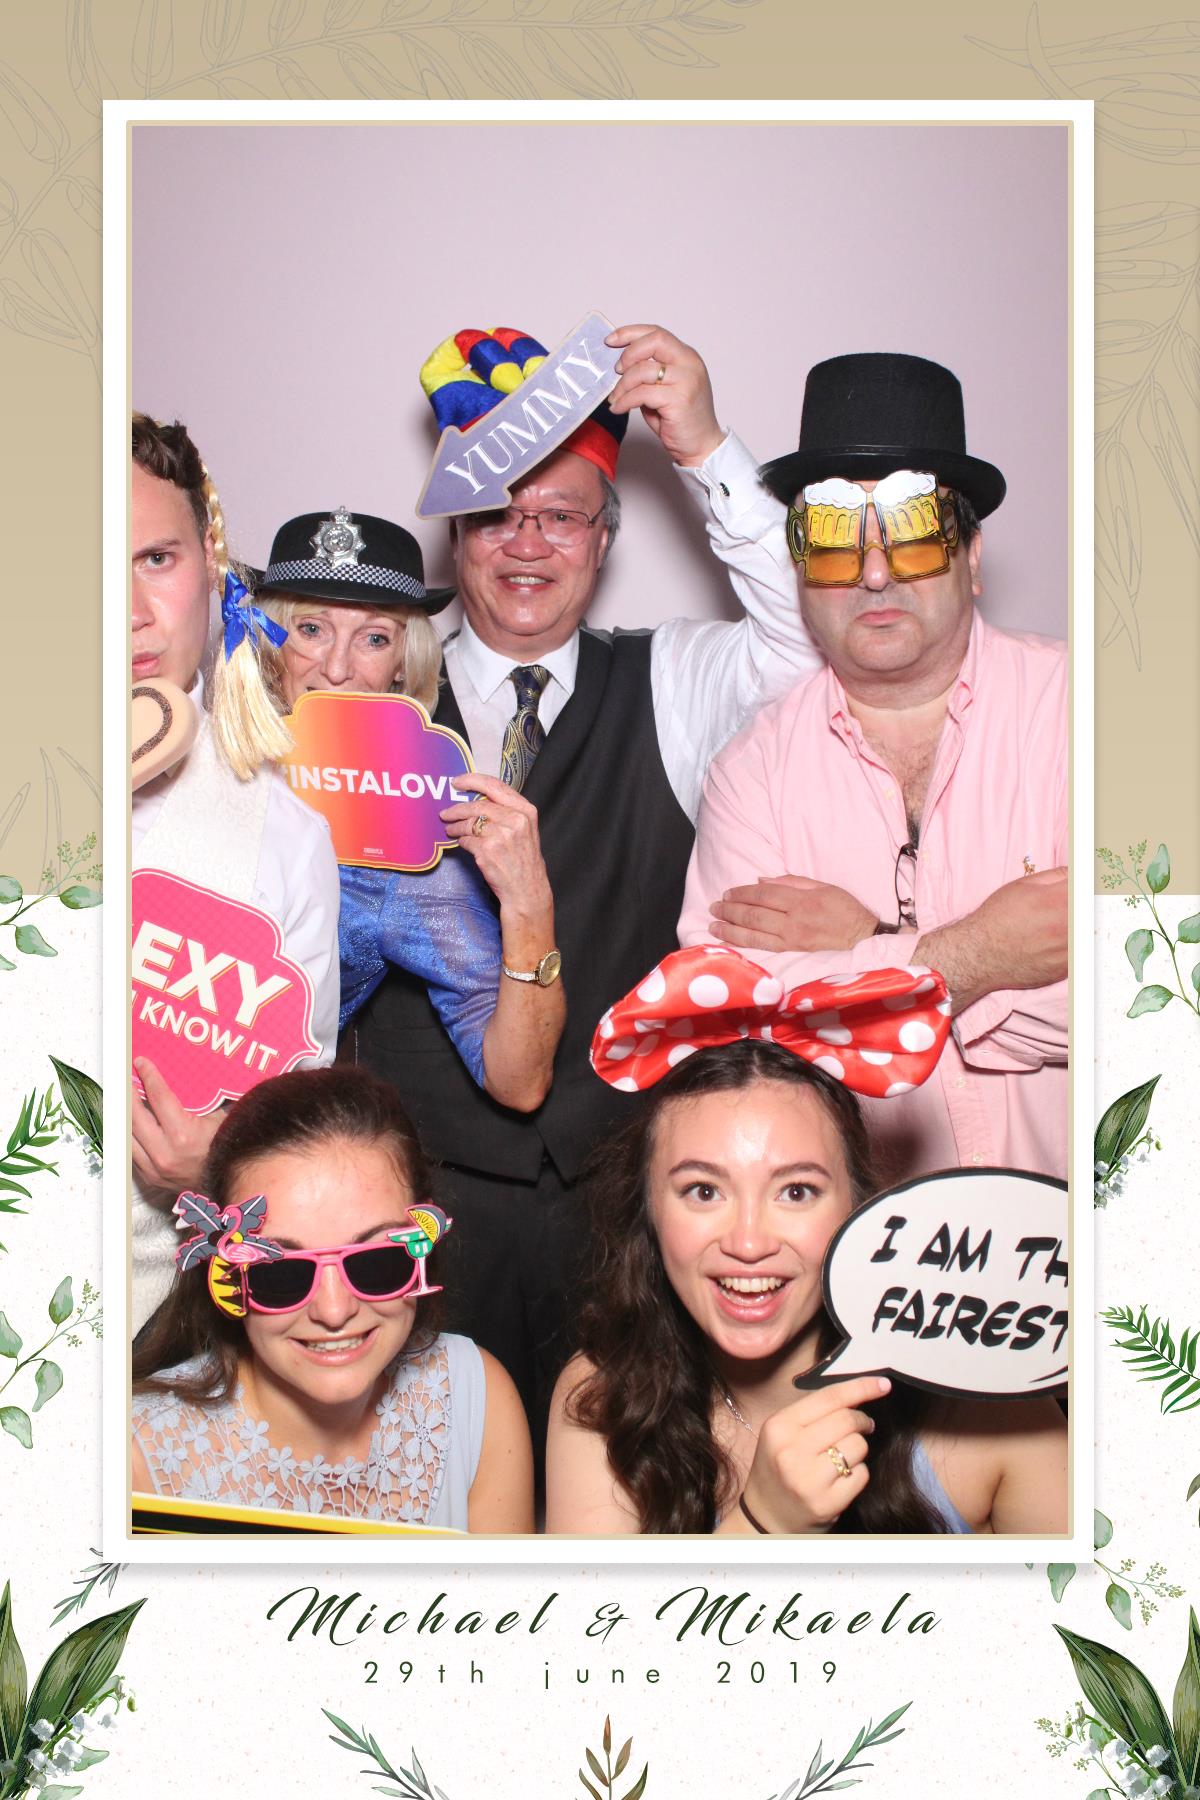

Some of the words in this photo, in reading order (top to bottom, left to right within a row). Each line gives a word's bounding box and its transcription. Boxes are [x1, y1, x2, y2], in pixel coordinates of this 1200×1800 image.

[445, 338, 607, 495] YUMMY
[132, 920, 294, 1030] EXY
[139, 996, 246, 1059] KNOW
[244, 1040, 279, 1073] IT
[870, 1215, 907, 1263] I
[917, 1222, 992, 1273] AM
